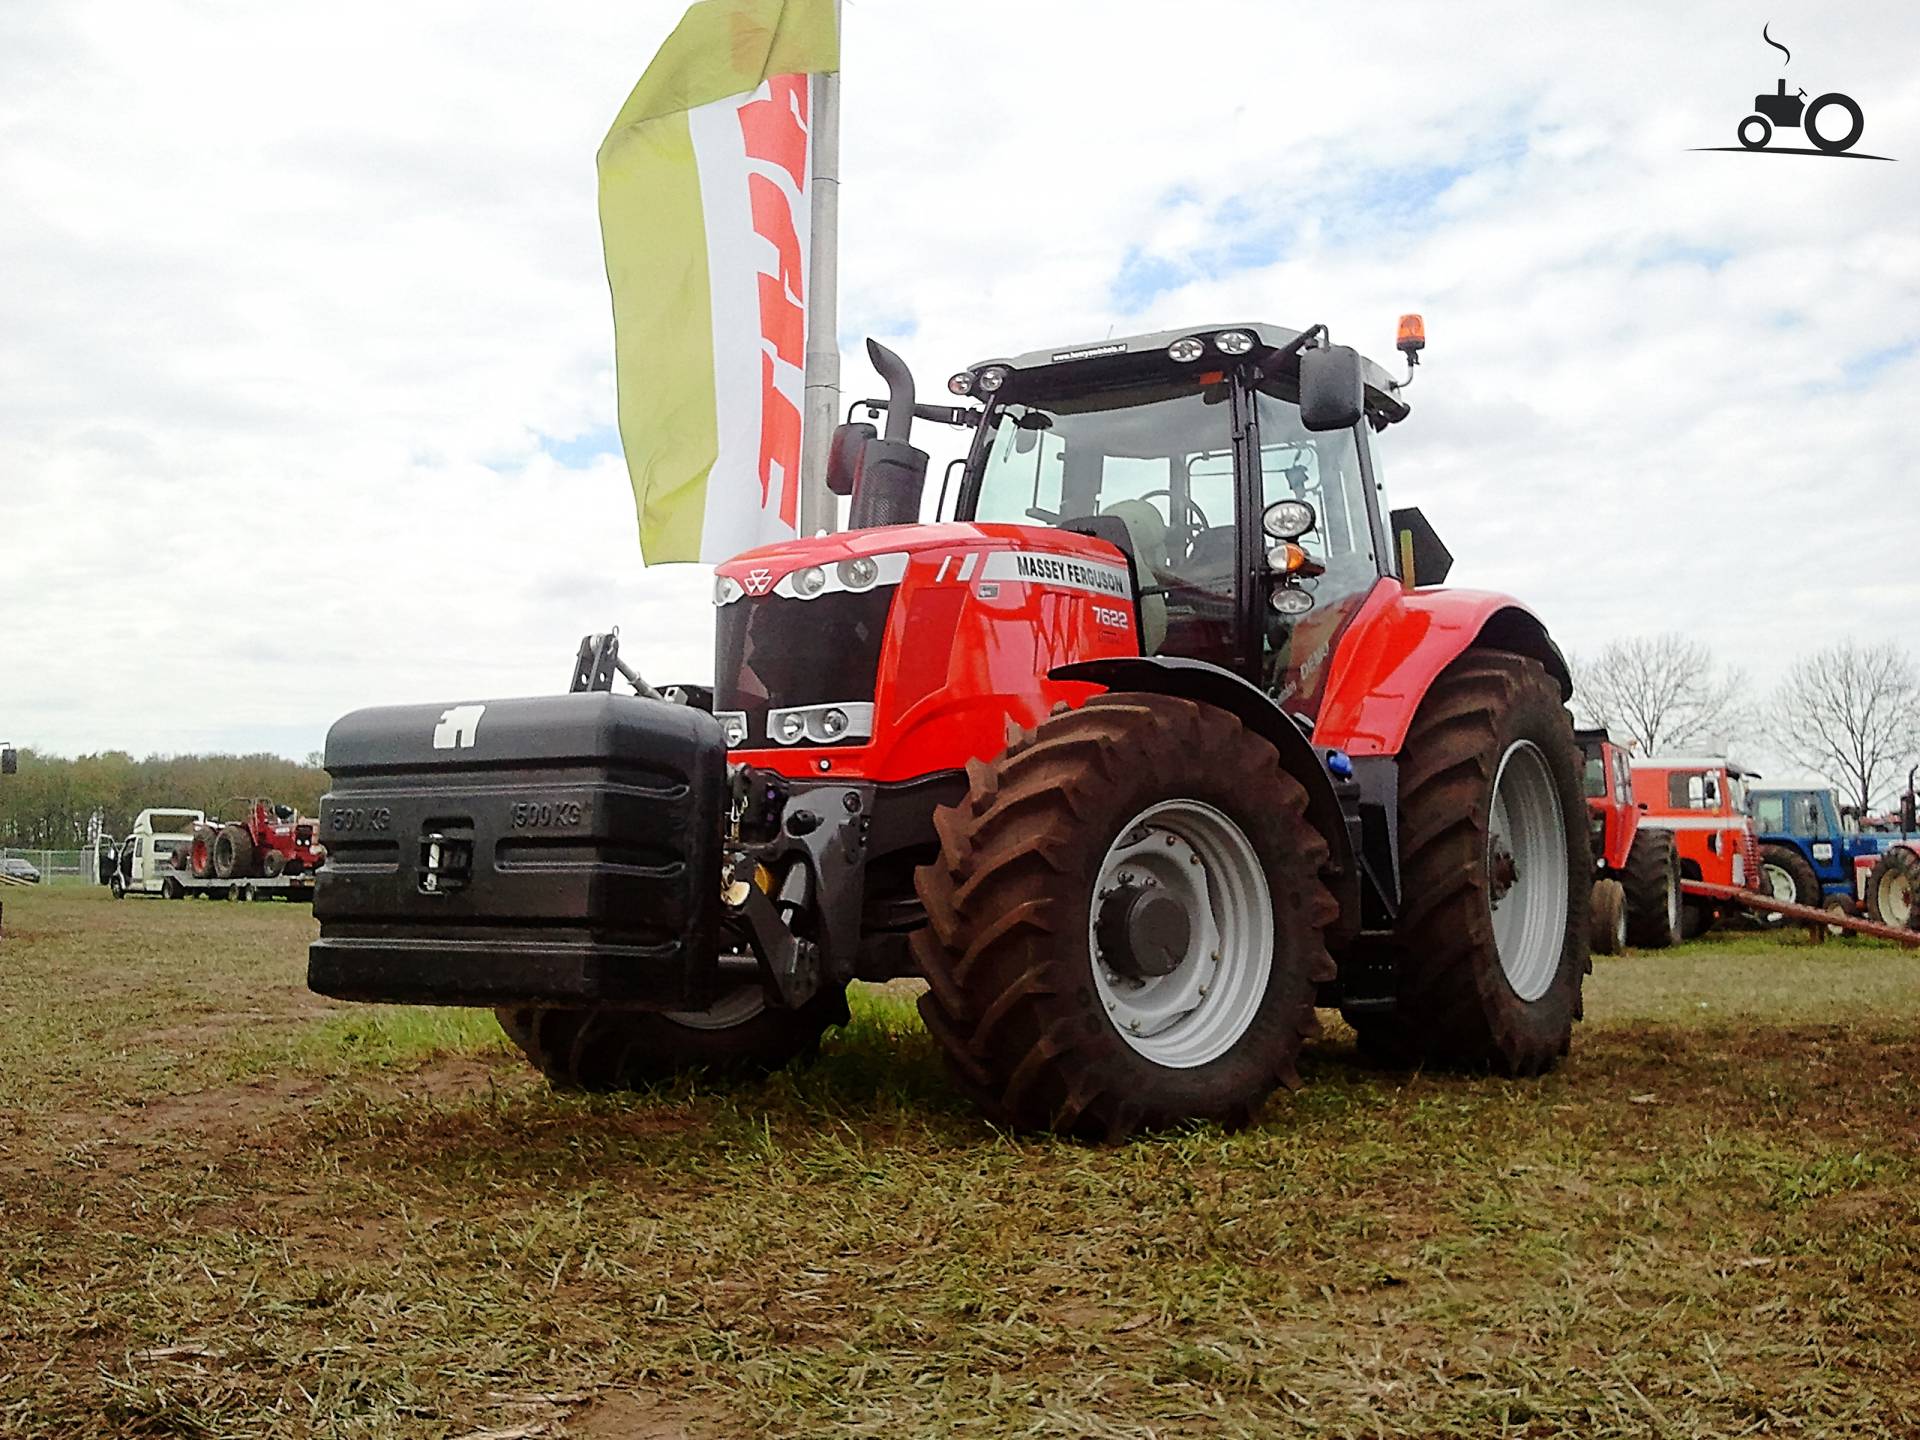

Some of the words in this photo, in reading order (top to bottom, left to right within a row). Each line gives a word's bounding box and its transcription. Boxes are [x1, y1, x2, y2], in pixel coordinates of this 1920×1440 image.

[1017, 556, 1065, 581] MASSEY
[1067, 563, 1124, 594] FERGUSON
[1092, 606, 1129, 630] 7622
